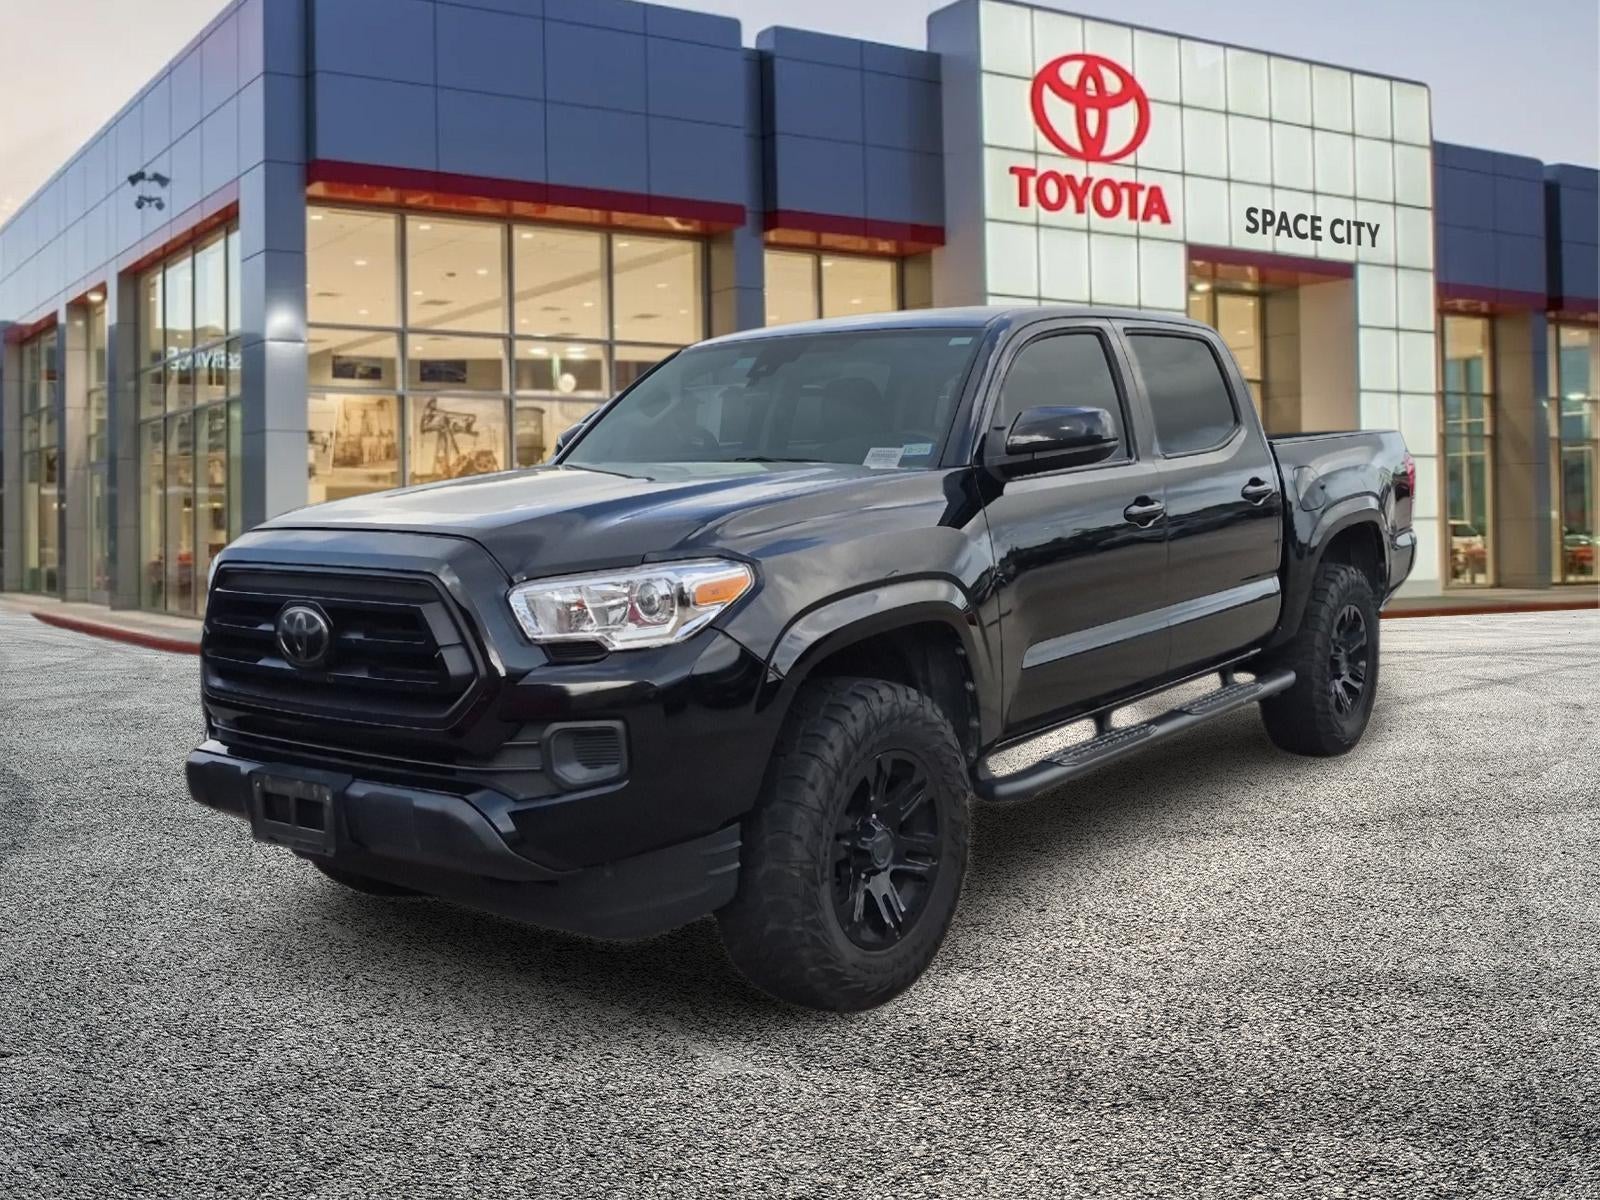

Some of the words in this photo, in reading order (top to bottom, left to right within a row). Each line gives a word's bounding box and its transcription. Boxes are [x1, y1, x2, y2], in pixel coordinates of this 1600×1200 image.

[1009, 166, 1171, 224] TOYOTA
[1245, 206, 1323, 242] SPACE
[1329, 217, 1381, 248] CITY
